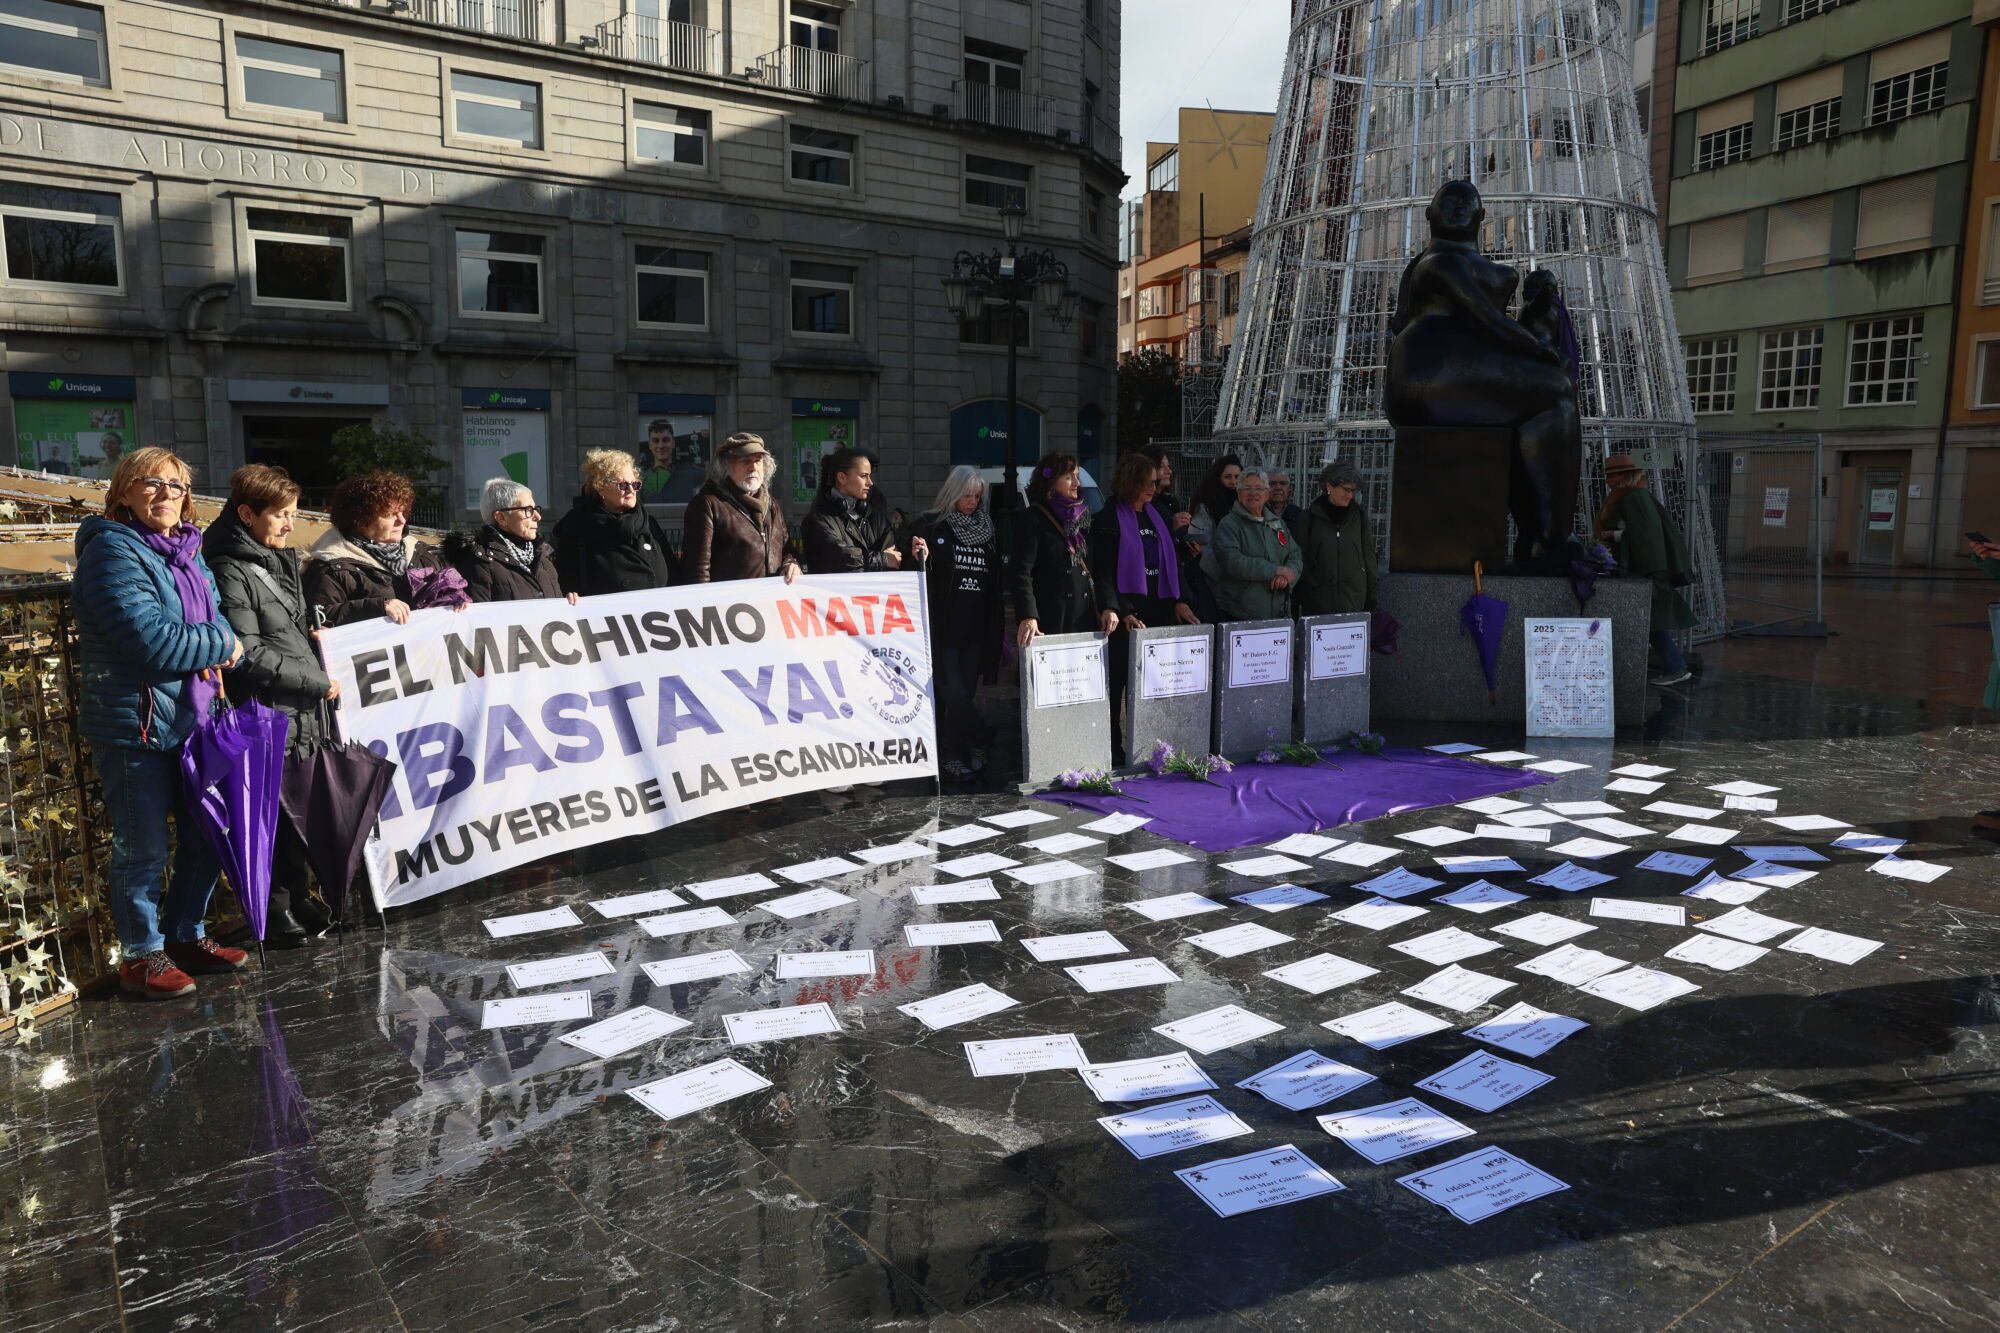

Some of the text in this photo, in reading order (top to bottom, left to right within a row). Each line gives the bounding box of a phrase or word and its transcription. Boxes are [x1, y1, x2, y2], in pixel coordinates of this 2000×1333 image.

[0, 118, 61, 153] DE
[121, 137, 357, 188] AHORROS
[400, 169, 448, 198] DE
[65, 383, 102, 394] Unicaja
[303, 390, 334, 400] Unicaja
[501, 395, 527, 405] Unicaja
[465, 415, 516, 426] Hablamos
[466, 427, 511, 436] el mismo
[466, 437, 500, 447] idioma
[1533, 625, 1555, 633] 2025
[351, 593, 915, 709] EL MACHISMO MATA
[902, 657, 917, 675] DE
[721, 659, 854, 727] YA!
[868, 693, 923, 725] LA ESCANDALERA
[394, 736, 928, 885] MUYERES DE LA ESCANDALERA
[1238, 1170, 1269, 1182] Mujer
[1445, 1182, 1471, 1193] Ofelia
[1477, 1169, 1507, 1183] Pereira
[1217, 1188, 1243, 1199] Lloret
[1244, 1183, 1257, 1191] del
[1268, 1186, 1287, 1194] años
[1497, 1188, 1514, 1197] años
[1257, 1190, 1300, 1205] 04/09/2025
